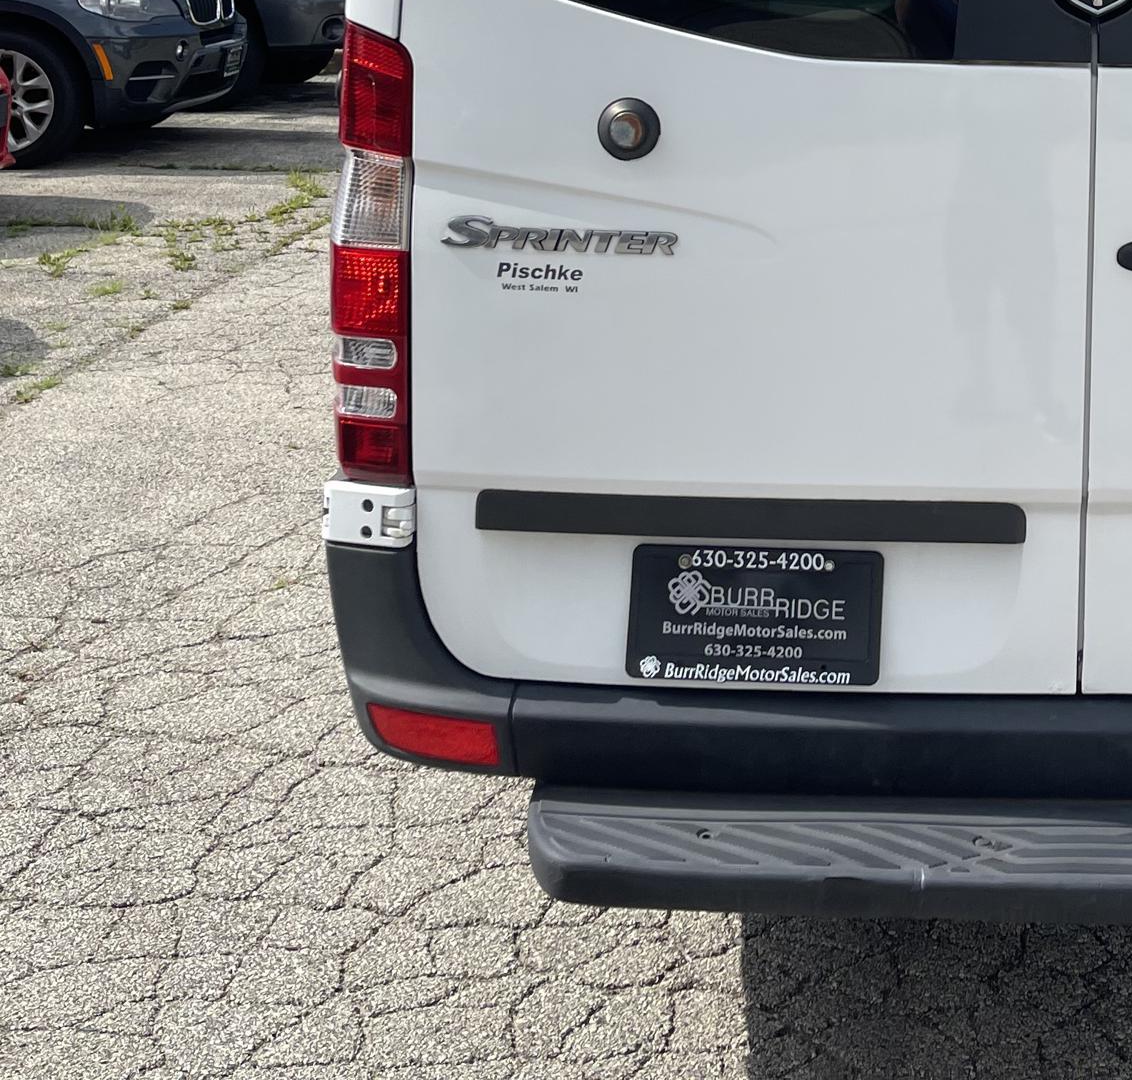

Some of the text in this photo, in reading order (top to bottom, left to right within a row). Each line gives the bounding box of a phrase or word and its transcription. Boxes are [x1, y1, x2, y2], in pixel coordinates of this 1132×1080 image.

[440, 214, 678, 256] SPRINTER
[497, 262, 583, 281] Pischke
[501, 283, 526, 291] West
[529, 284, 558, 292] Salem
[691, 549, 825, 570] 630-325-4200
[705, 607, 769, 617] MOTOR SALES
[662, 621, 847, 640] BurrRidgeMotorSales.com
[704, 643, 803, 659] 630-325-4200
[664, 662, 851, 684] BurrRidgeMotorSales.com
